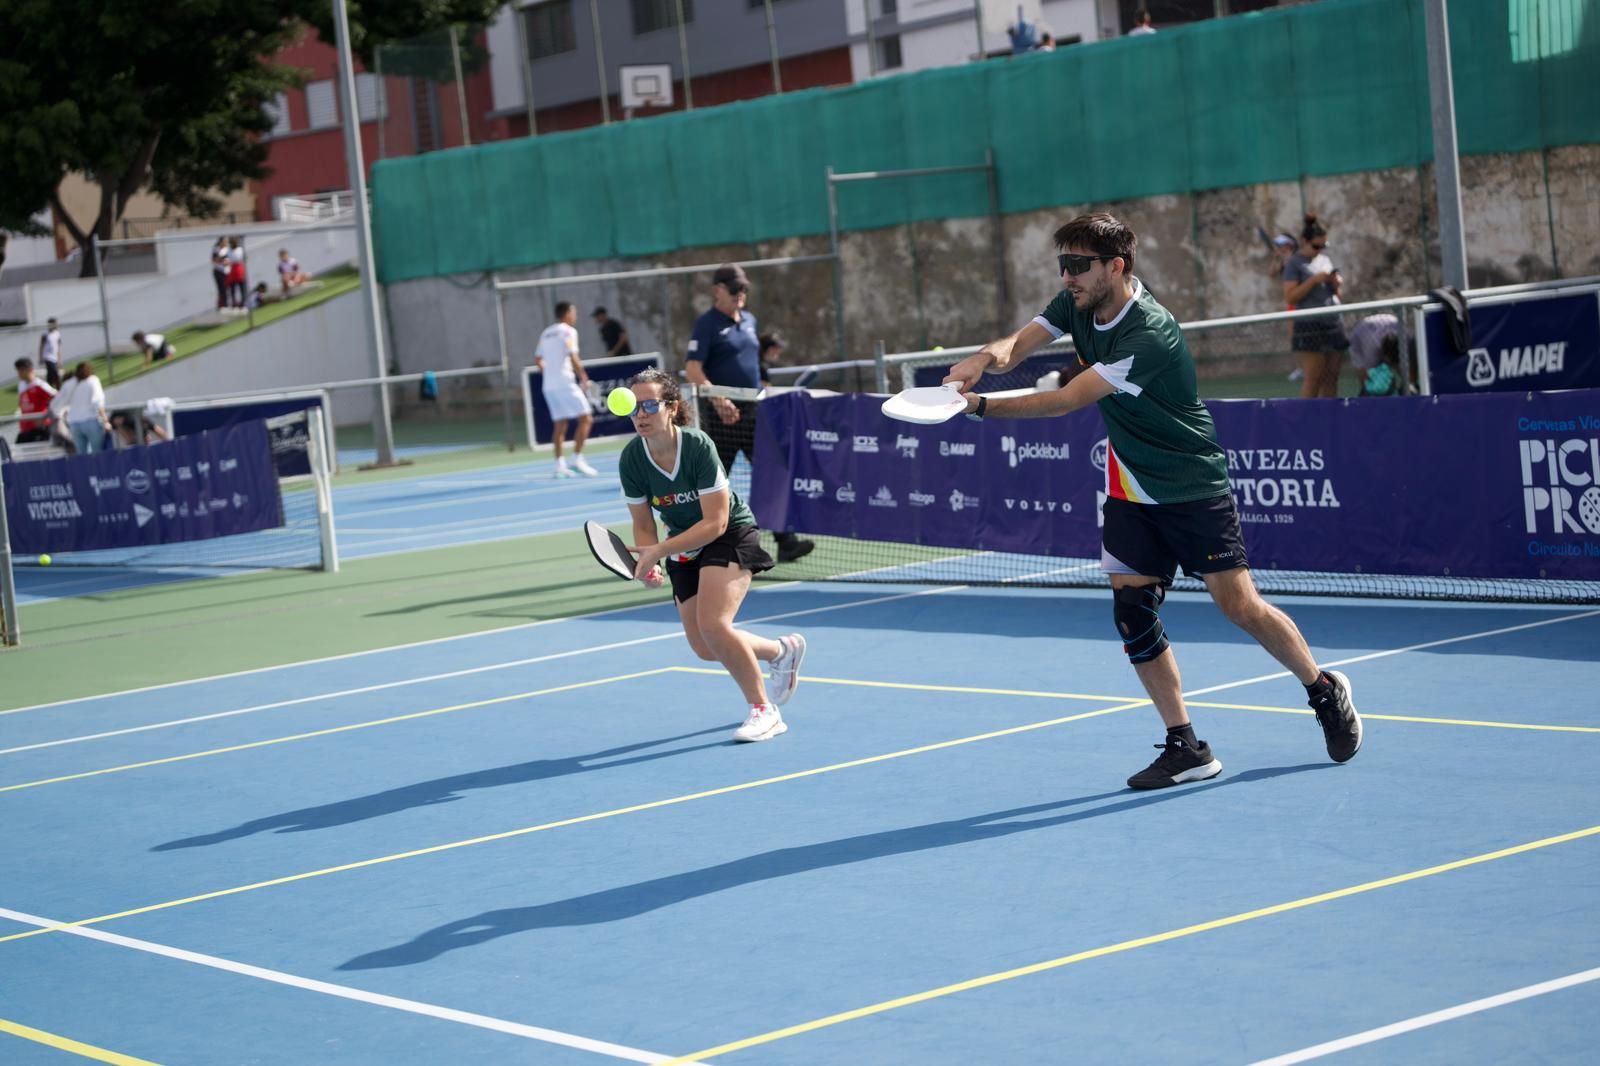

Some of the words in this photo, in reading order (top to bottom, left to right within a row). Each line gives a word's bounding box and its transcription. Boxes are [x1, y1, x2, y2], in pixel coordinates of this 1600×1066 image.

[1498, 341, 1566, 379] MAPEI
[1018, 442, 1070, 462] picklebull
[1227, 448, 1325, 470] RVEZAS
[1229, 478, 1340, 507] TORIA
[27, 498, 82, 520] VICTORIA
[1005, 498, 1072, 513] VOLVO
[1274, 513, 1295, 524] 1928
[1527, 540, 1581, 556] Circuito
